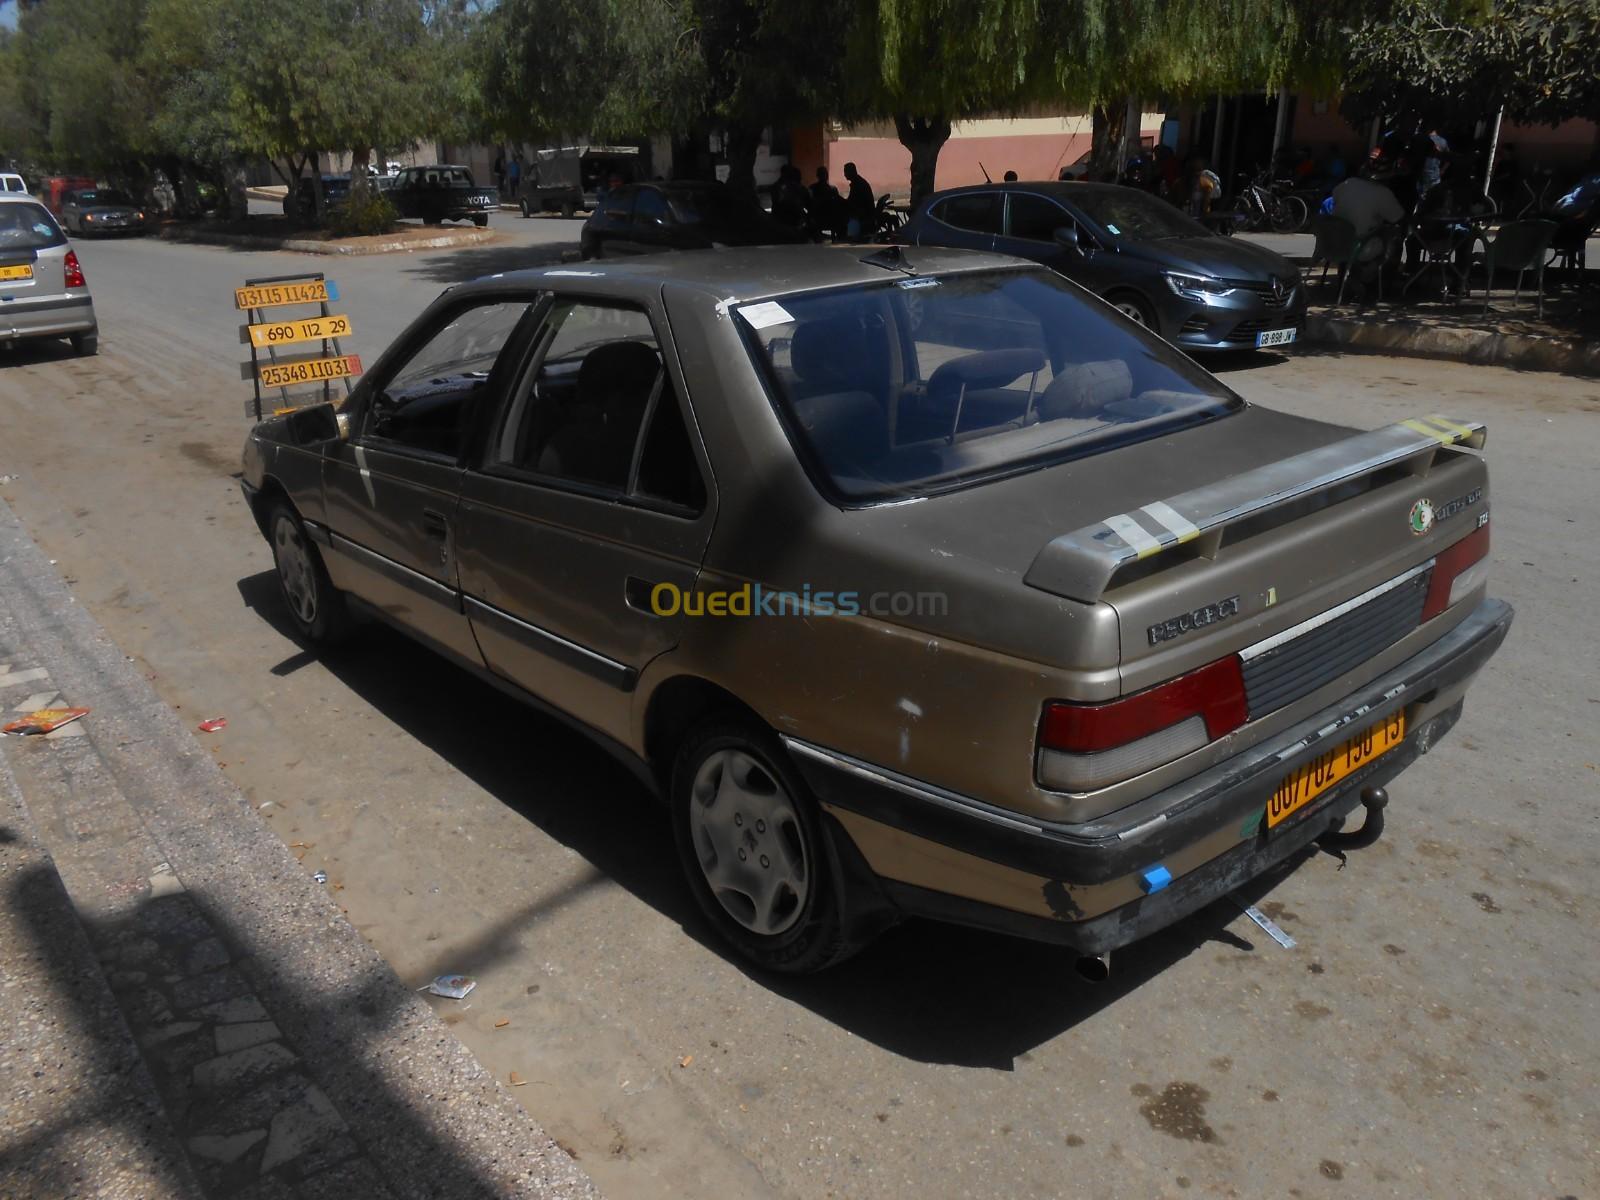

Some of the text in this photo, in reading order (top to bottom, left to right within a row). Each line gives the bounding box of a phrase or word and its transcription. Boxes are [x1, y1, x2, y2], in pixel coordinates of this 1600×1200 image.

[458, 196, 491, 205] YOTA
[268, 319, 346, 341] 690 112 29
[263, 365, 308, 386] 25348
[1148, 594, 1240, 646] PEUGEOT
